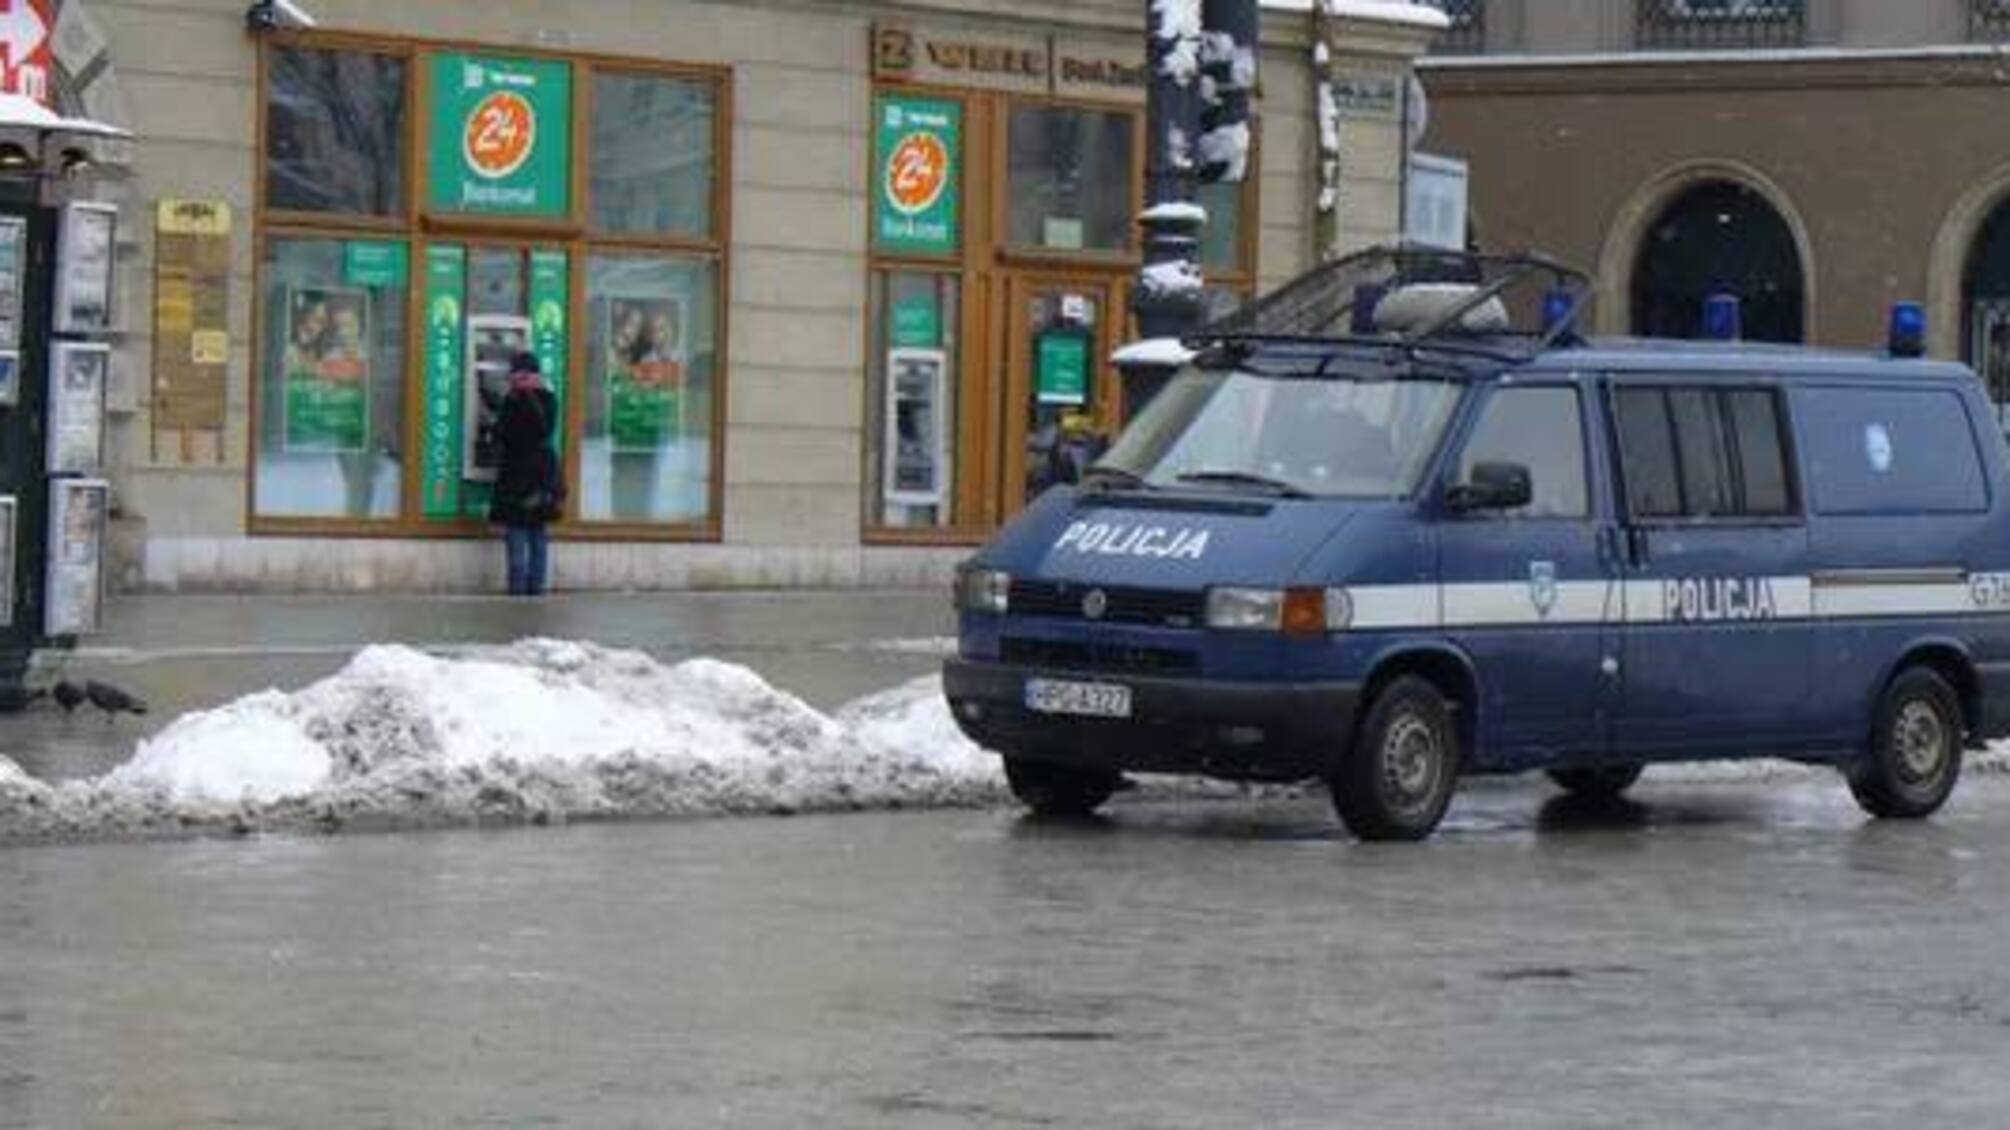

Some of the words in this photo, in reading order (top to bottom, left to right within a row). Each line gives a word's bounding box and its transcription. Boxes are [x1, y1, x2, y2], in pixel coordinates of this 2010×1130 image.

[474, 106, 519, 153] 24
[894, 144, 934, 192] 24
[1054, 520, 1210, 560] POLICJA
[1662, 577, 1778, 621] POLICJA
